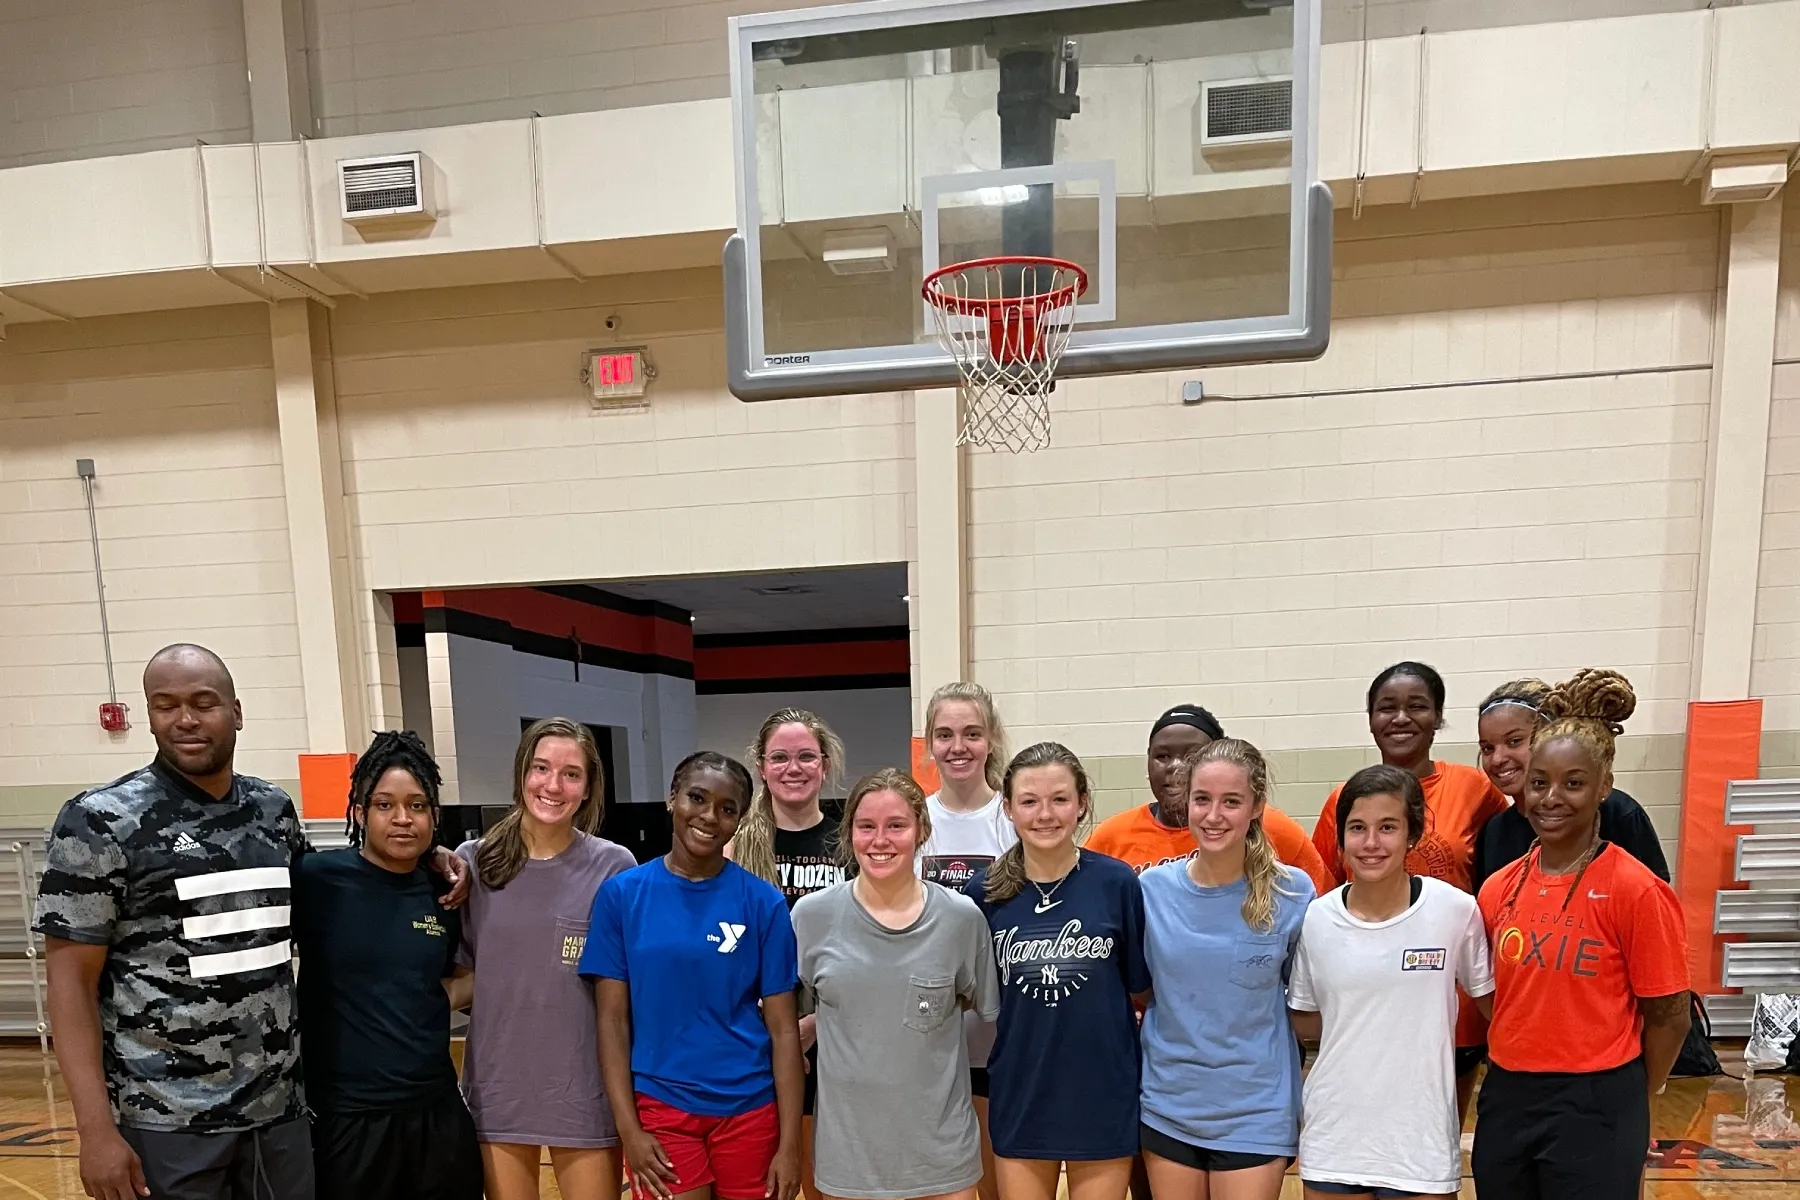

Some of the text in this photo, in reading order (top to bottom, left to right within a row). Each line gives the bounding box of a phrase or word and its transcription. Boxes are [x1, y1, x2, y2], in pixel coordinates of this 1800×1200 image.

[600, 354, 634, 384] EXIT
[173, 842, 201, 851] adidas
[776, 855, 835, 864] ILL-TOOLEN
[793, 864, 846, 888] DOZEN
[940, 869, 975, 880] FINALS
[1530, 912, 1586, 929] LEVEL
[707, 934, 720, 943] the
[562, 946, 583, 958] GRA
[994, 919, 1114, 986] Yankees
[1500, 927, 1605, 977] OXIE
[1016, 973, 1088, 1001] BASEBALL
